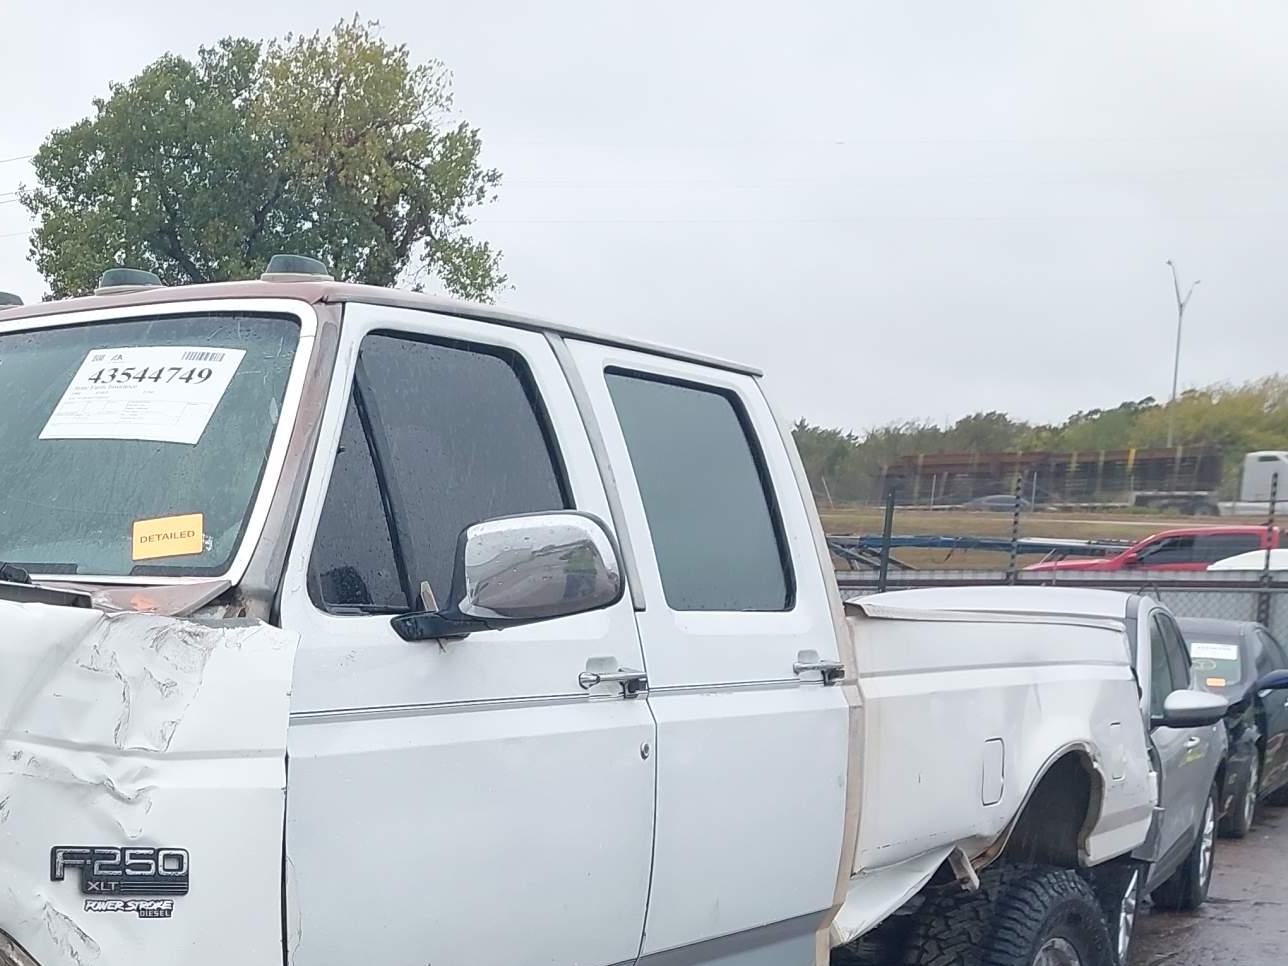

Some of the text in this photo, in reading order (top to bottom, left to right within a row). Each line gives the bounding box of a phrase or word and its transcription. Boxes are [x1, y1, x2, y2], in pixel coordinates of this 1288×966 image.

[88, 366, 213, 385] 43544749
[139, 530, 196, 544] DETAILED
[87, 881, 119, 891] XLT
[84, 899, 173, 912] POWER STROKE
[139, 910, 171, 918] DIESEL
